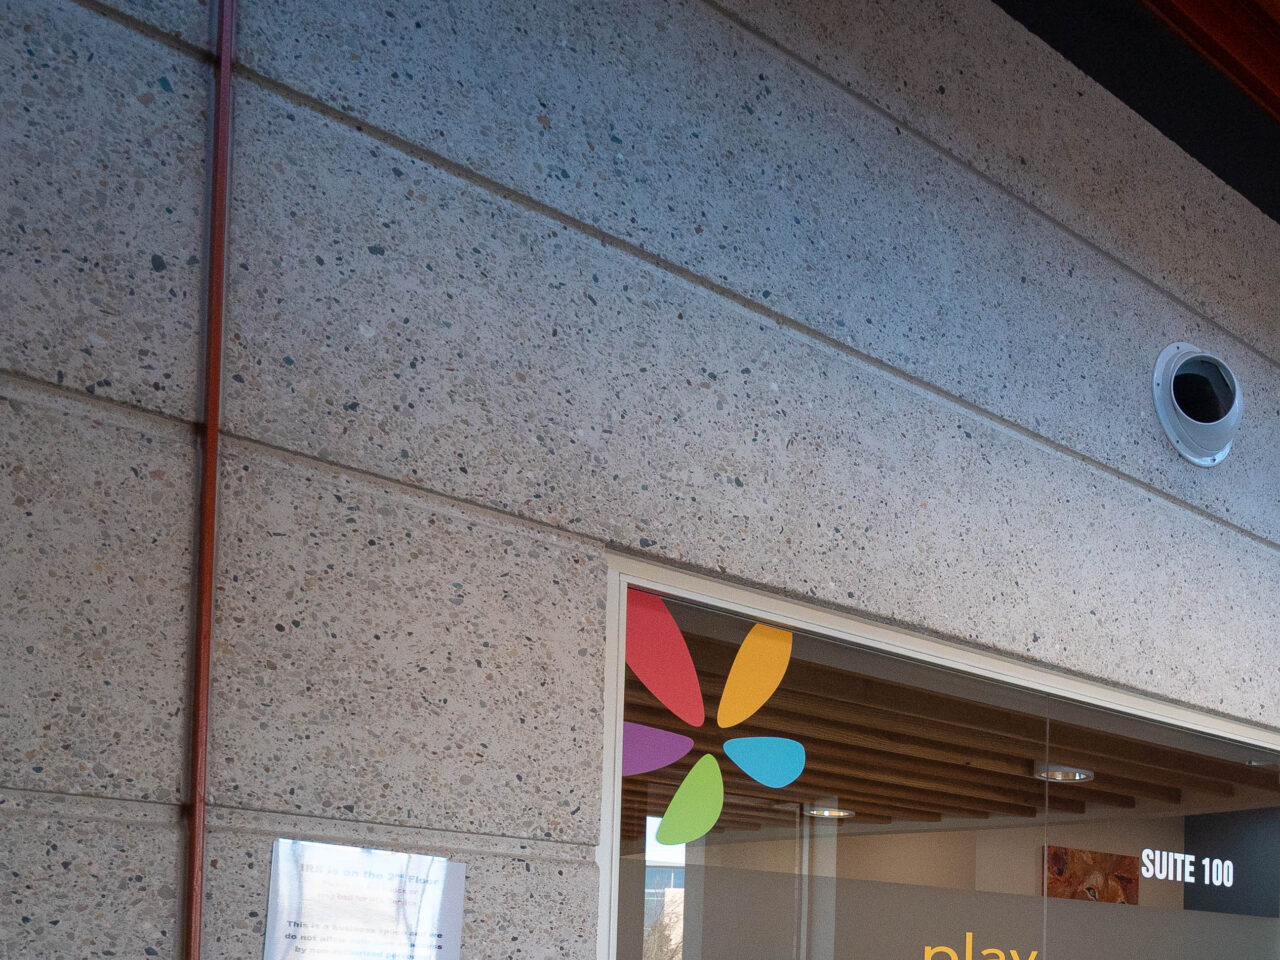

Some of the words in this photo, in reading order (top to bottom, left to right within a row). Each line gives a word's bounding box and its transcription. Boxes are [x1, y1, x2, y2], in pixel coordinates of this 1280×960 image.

[1141, 848, 1195, 883] SUITE
[1202, 857, 1234, 887] 100
[287, 920, 307, 928] This
